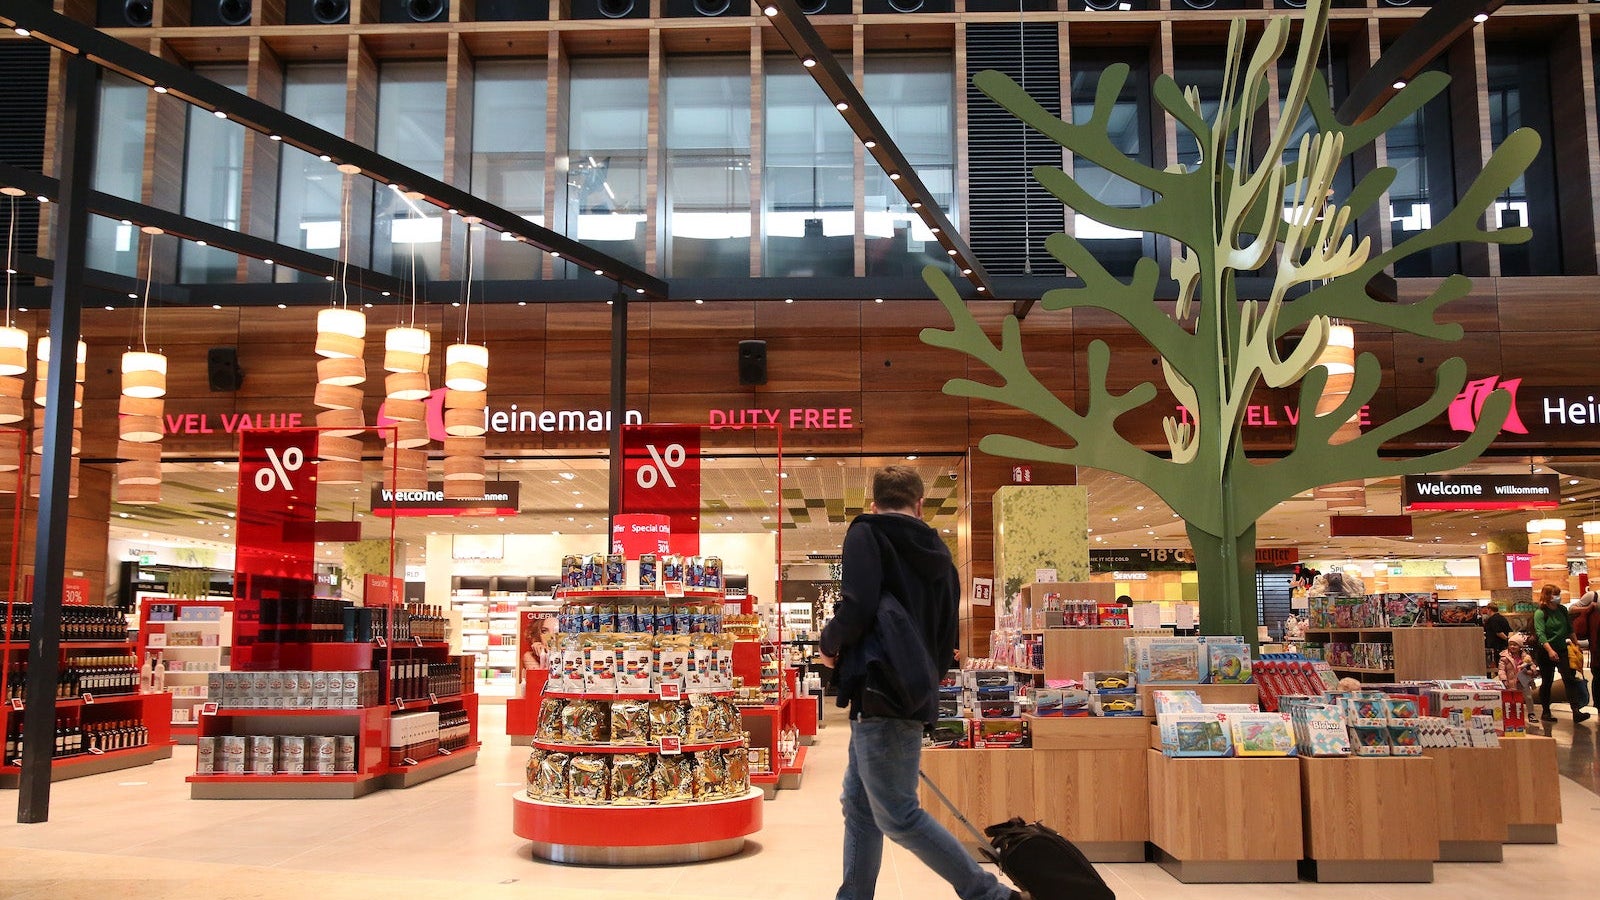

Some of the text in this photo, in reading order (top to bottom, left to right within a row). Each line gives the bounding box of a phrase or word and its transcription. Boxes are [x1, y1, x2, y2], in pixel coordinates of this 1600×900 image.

[1543, 396, 1600, 424] Hei
[484, 404, 642, 433] eineman
[708, 408, 853, 430] DUTY FREE
[1417, 482, 1549, 495] Welcome Willkommen
[381, 489, 444, 502] Welcome
[631, 524, 658, 534] Special
[613, 543, 624, 553] 0%
[65, 590, 82, 602] 30%
